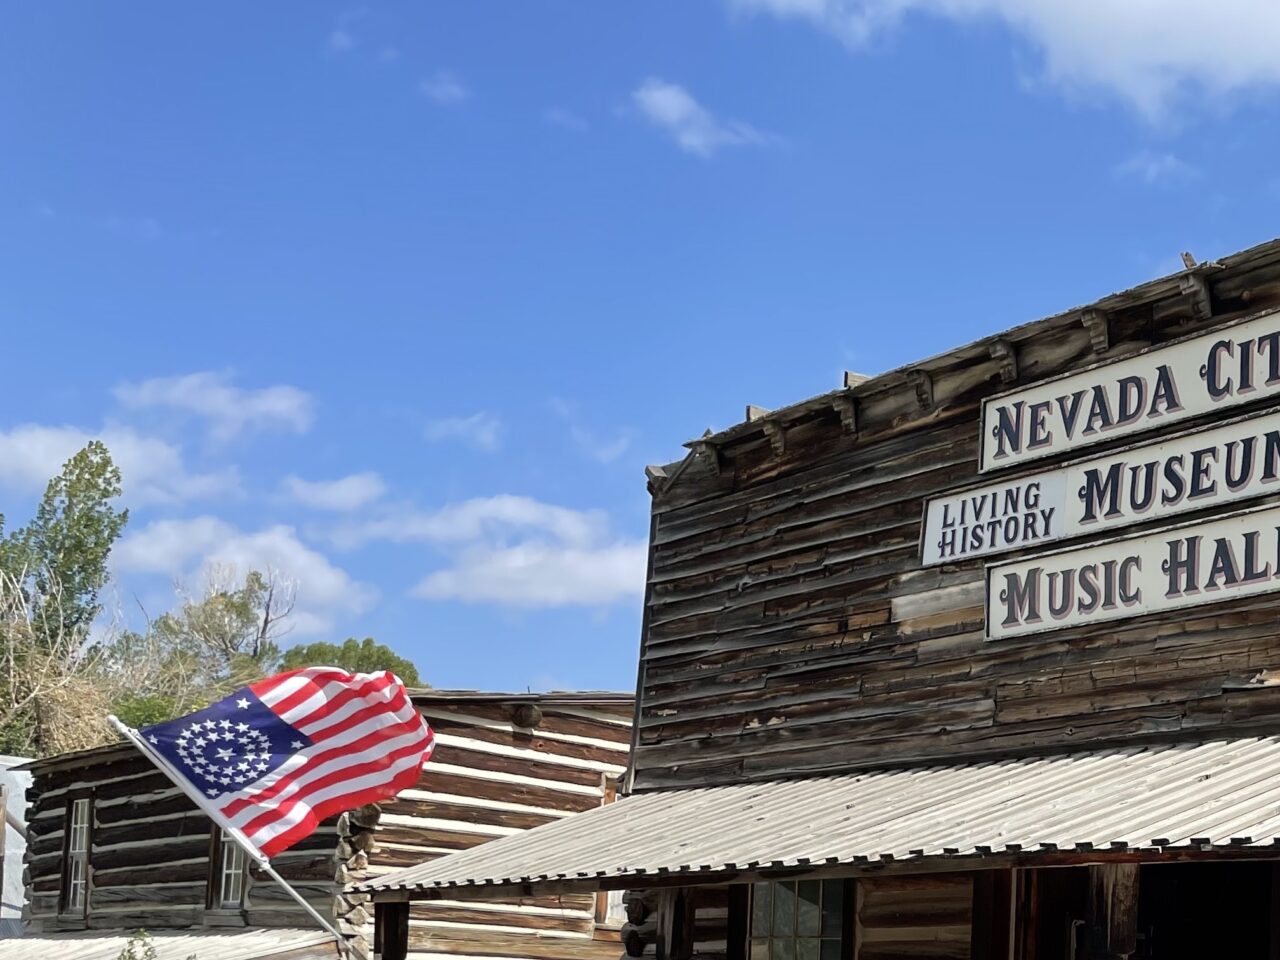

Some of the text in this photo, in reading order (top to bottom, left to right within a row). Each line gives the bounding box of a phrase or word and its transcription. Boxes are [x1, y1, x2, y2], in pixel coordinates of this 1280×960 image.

[992, 364, 1184, 460] NEVADA
[938, 507, 1055, 559] HISTORY
[942, 482, 1041, 529] LIVING
[1000, 555, 1142, 629] MUSIC
